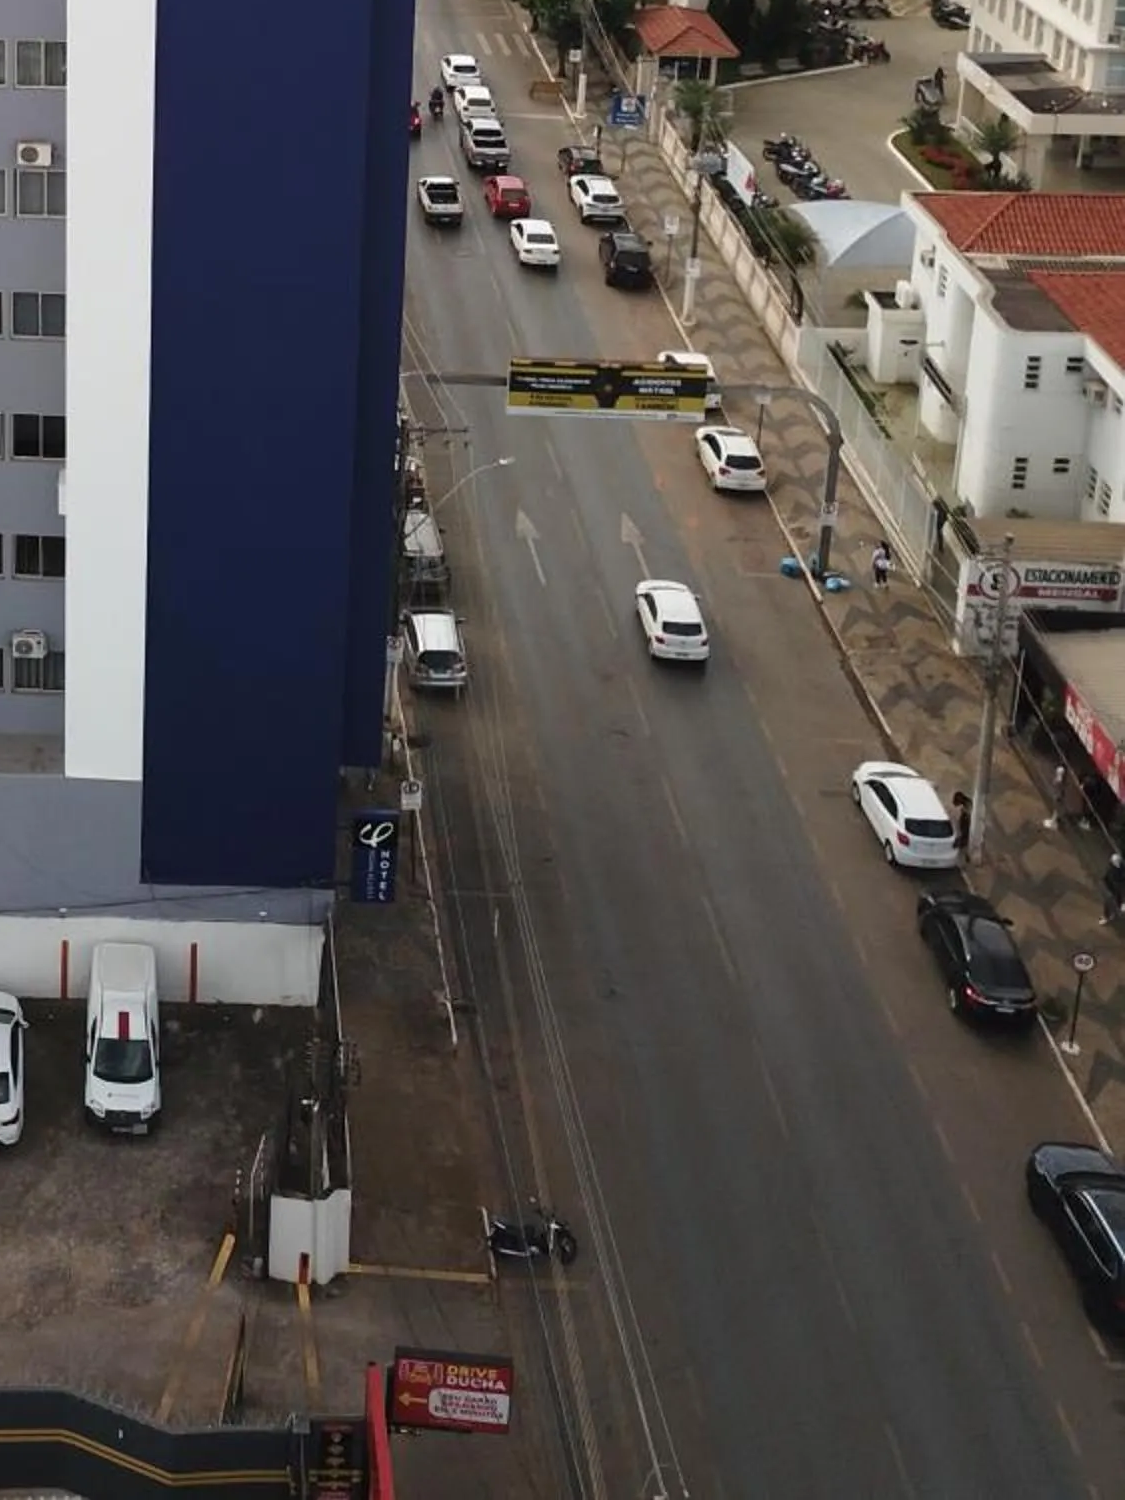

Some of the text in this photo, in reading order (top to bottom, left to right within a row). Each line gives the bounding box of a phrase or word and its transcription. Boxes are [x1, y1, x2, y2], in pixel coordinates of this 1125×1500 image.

[378, 850, 390, 901] HOTEL
[446, 1364, 498, 1379] DRIVE
[446, 1375, 507, 1391] DUCHA
